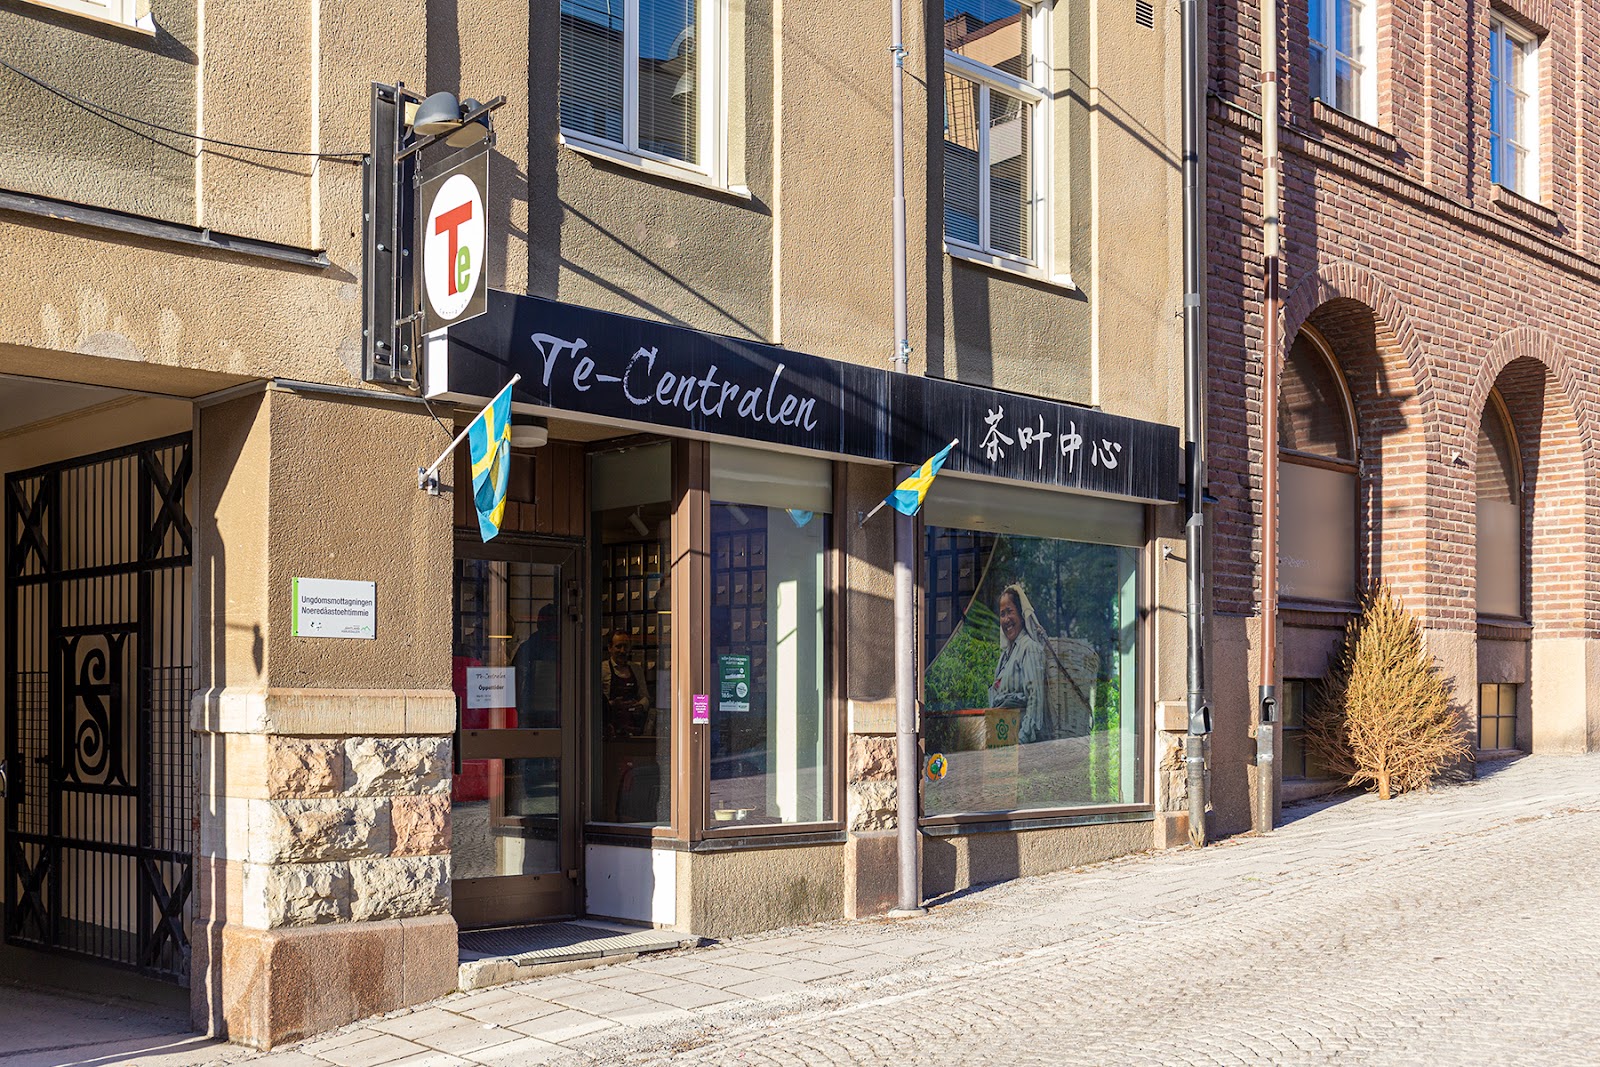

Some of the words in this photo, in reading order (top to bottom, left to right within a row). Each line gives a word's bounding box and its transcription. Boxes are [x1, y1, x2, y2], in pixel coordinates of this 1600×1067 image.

[434, 199, 473, 297] Te
[530, 332, 818, 432] Te-Centralen
[979, 405, 1122, 474] 茶叶中心
[301, 595, 373, 607] Ungdomsmottagningen
